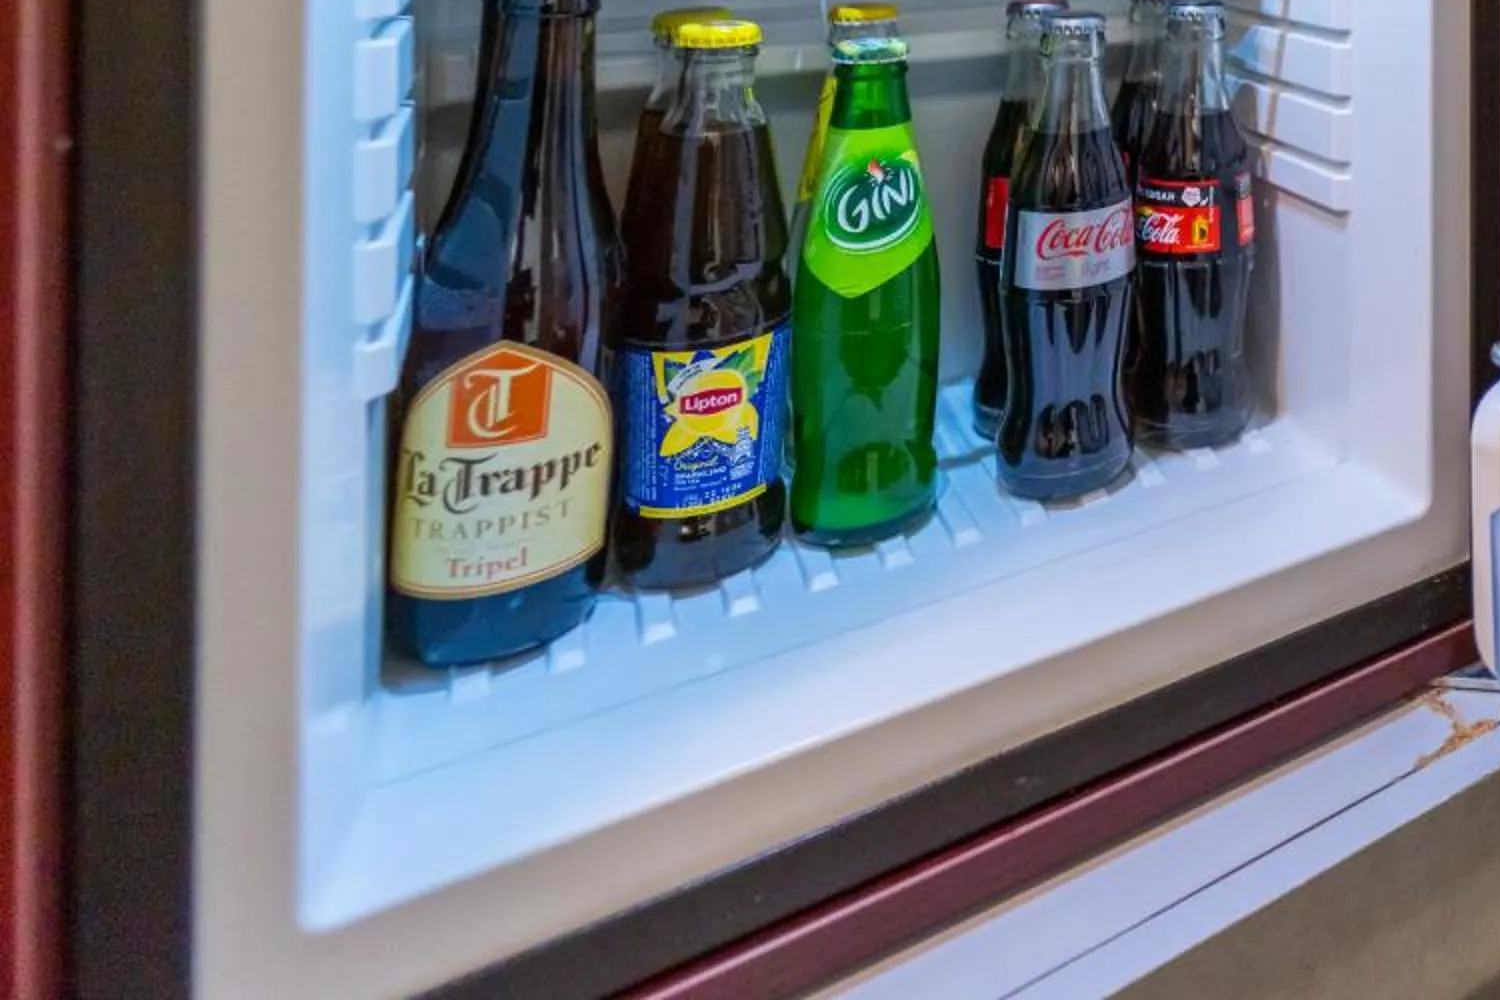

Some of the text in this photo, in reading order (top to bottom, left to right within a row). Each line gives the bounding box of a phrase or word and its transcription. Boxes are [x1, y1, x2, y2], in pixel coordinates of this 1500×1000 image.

[684, 391, 738, 413] Lipton
[438, 441, 602, 515] Trappe
[410, 500, 575, 540] TRAPPIST
[443, 547, 528, 581] Tripel
